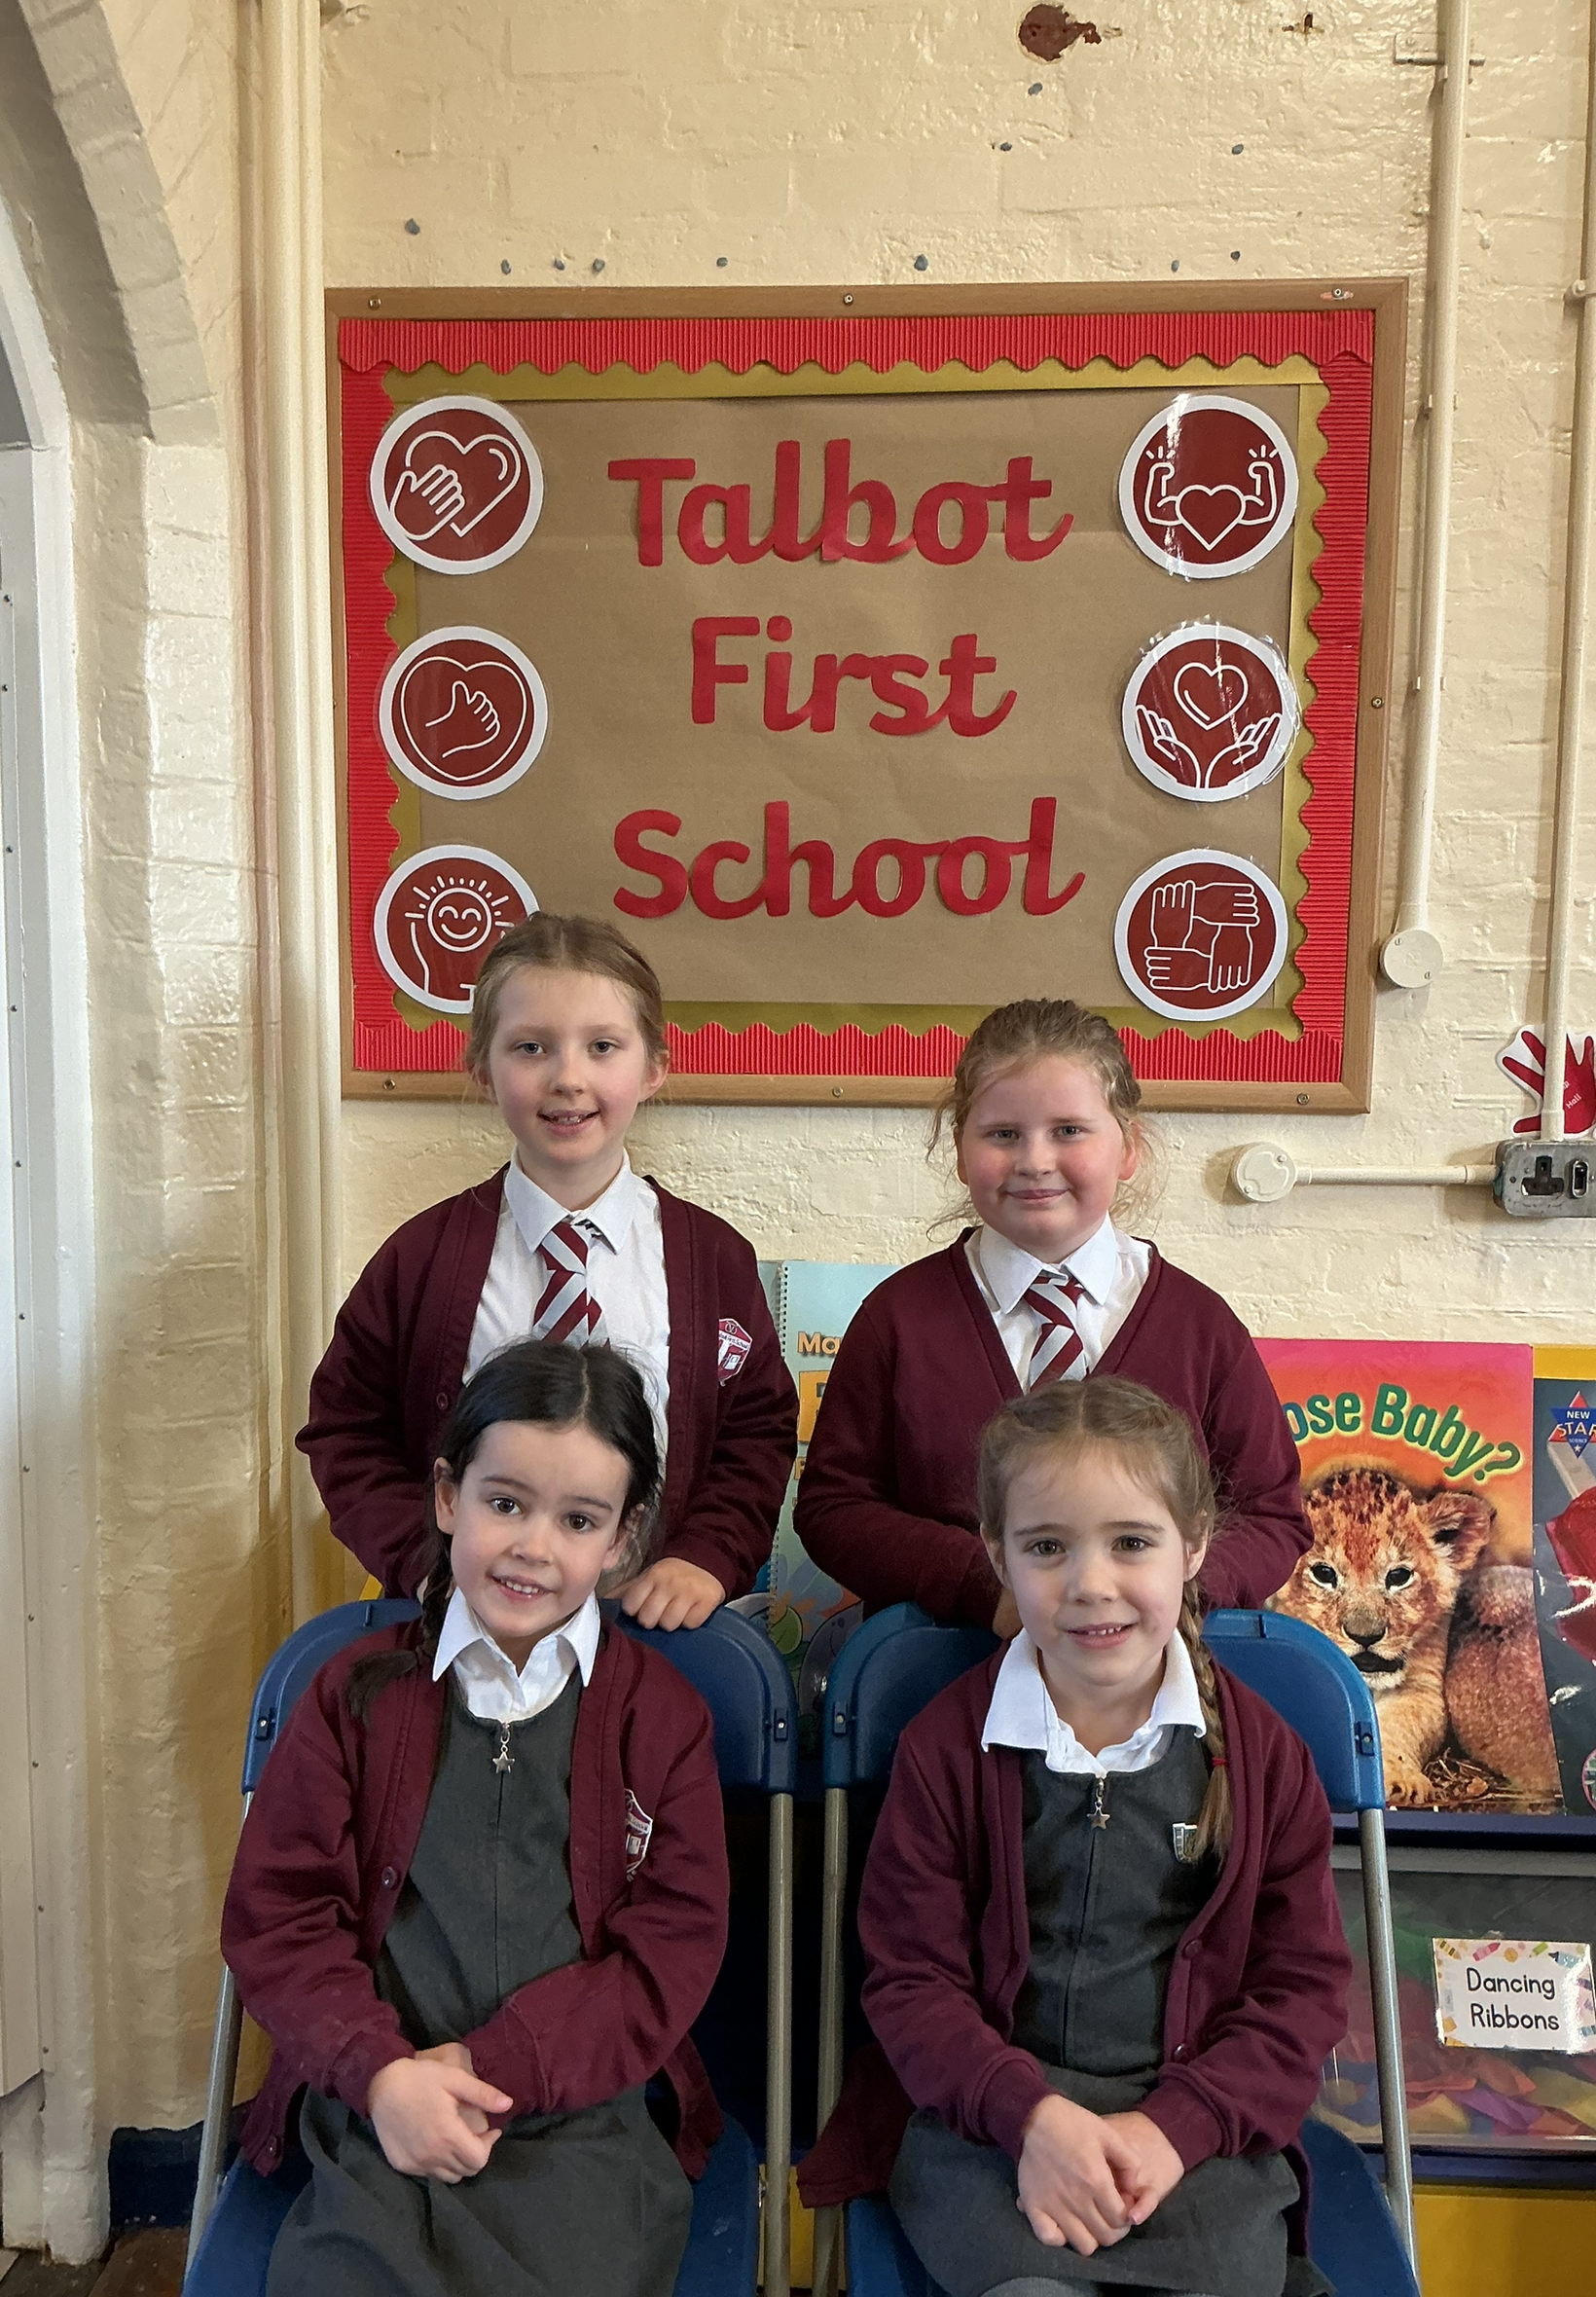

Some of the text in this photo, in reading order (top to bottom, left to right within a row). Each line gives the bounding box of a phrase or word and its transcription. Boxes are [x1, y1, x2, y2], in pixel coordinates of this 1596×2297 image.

[607, 438, 1074, 566] Talbot
[691, 615, 1018, 737] First
[613, 796, 1086, 920] School
[1565, 1093, 1582, 1109] Hall
[797, 1331, 842, 1355] Ma
[1566, 1410, 1590, 1419] NEW
[1281, 1382, 1522, 1482] ose Baby?
[1466, 1967, 1555, 2000] Dancing
[1469, 2003, 1560, 2030] Ribbons
